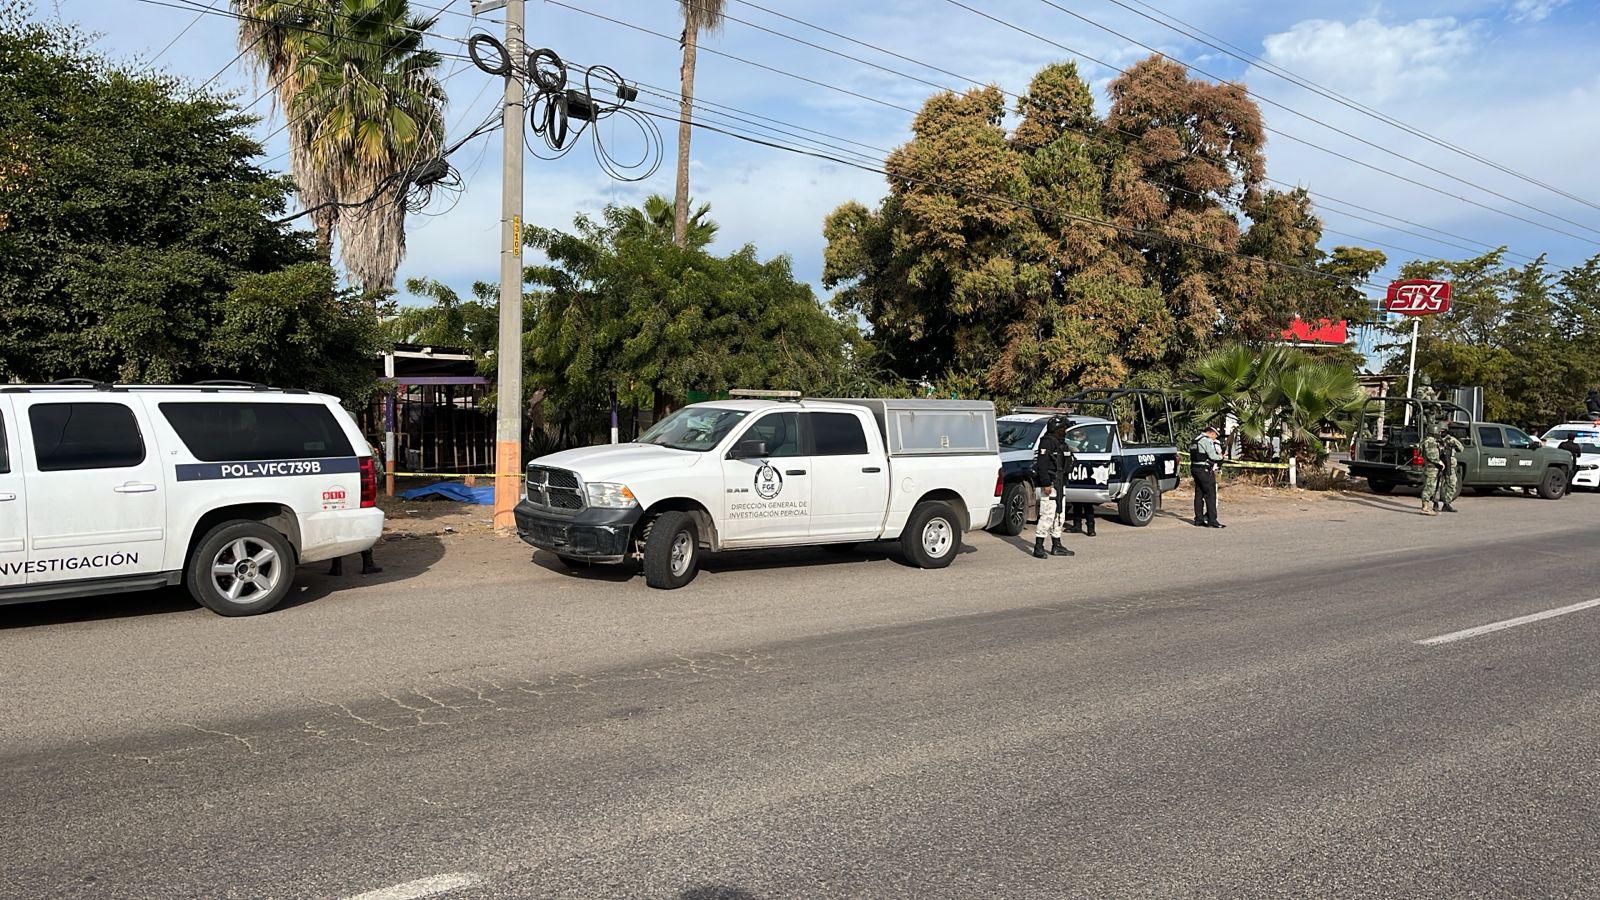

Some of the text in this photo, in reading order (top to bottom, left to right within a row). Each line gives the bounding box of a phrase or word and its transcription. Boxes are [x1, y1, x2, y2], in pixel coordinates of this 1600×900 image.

[1390, 284, 1443, 310] SIX
[221, 462, 321, 477] POL-VFC739B
[323, 491, 345, 500] 911
[730, 510, 779, 518] INVESTIGACIÓN
[0, 551, 139, 575] NVESTIGACIÓN
